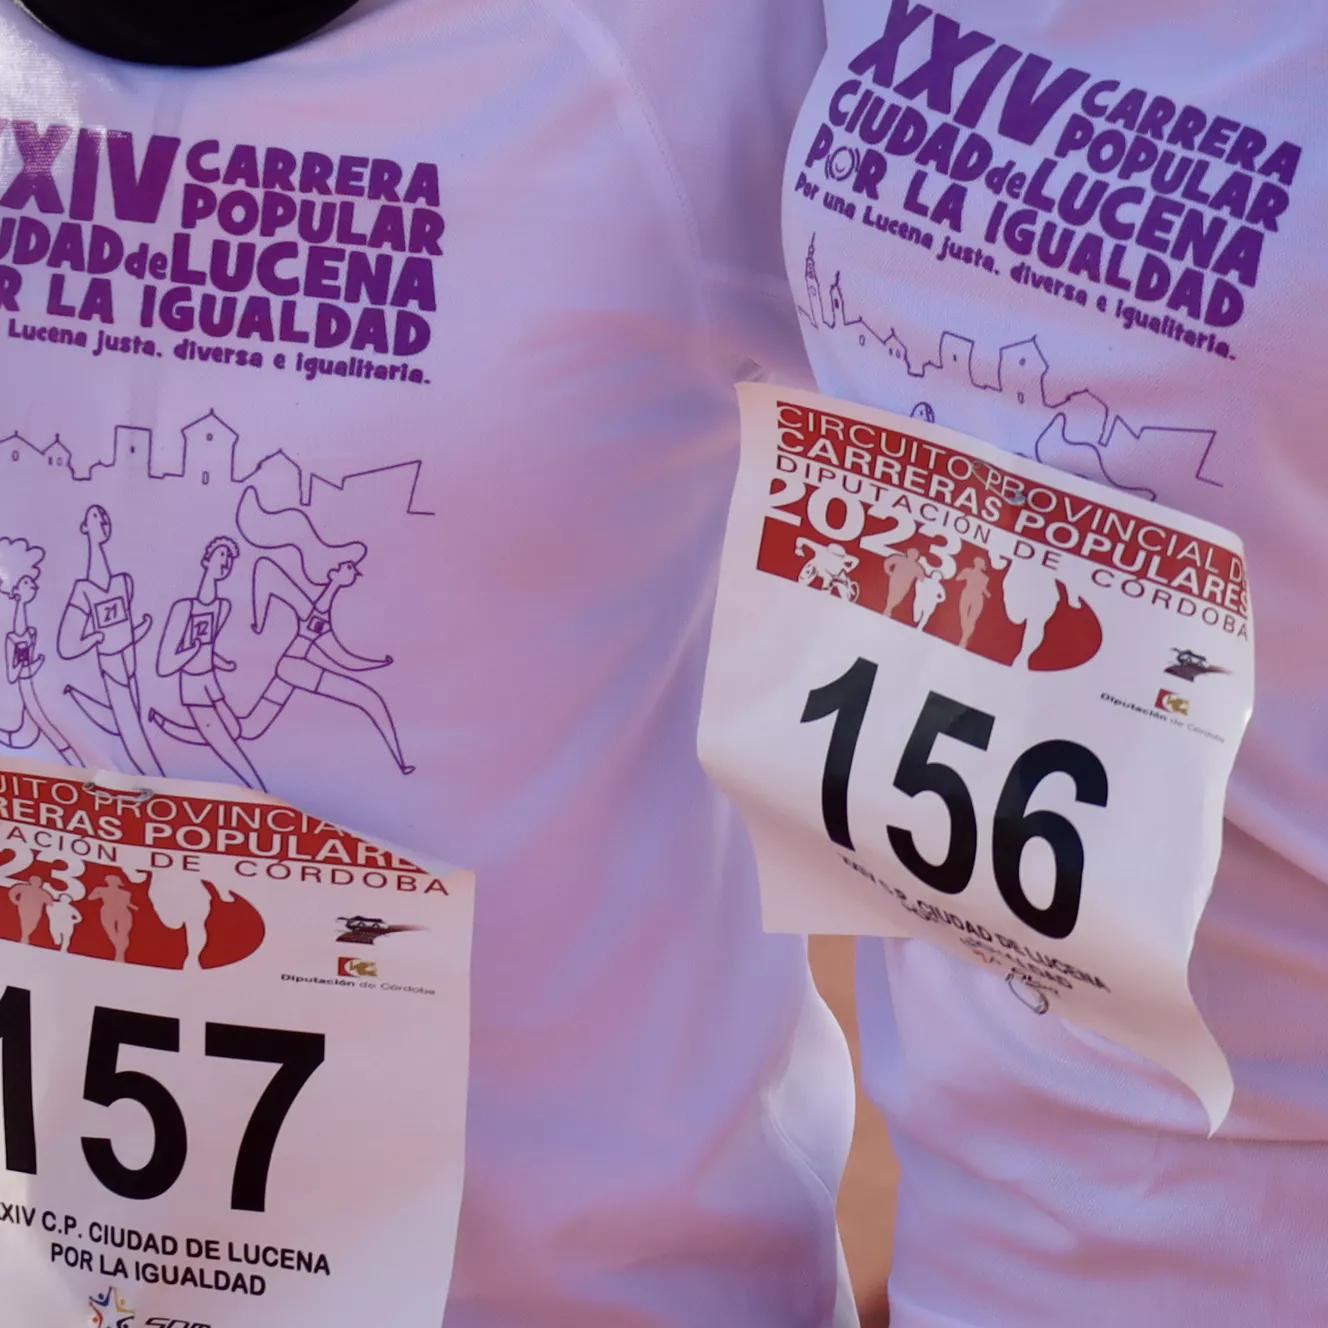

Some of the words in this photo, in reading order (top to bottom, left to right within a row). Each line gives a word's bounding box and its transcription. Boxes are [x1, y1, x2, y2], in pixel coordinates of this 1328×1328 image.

[186, 139, 441, 206] CARRERA
[1054, 113, 1289, 232] POPULAR
[1080, 79, 1302, 185] CARRERA
[181, 183, 445, 256] POPULAR
[803, 122, 888, 200] POR
[903, 169, 968, 232] LA
[985, 202, 1244, 327] IGUALDAD
[827, 79, 993, 183] CIUDAD
[985, 159, 1025, 202] de
[1025, 157, 1264, 287] LUCENA
[124, 241, 168, 280] de
[170, 232, 438, 311] LUCENA
[794, 171, 820, 201] Por
[823, 192, 856, 220] una
[862, 205, 933, 250] Lucena
[1009, 261, 1088, 311] diversa
[1095, 294, 1107, 313] e
[1116, 297, 1236, 361] igualitaria.
[8, 318, 87, 347] Lucena
[174, 339, 263, 369] diversa
[273, 352, 286, 369] e
[296, 353, 432, 385] igualitaria.
[46, 273, 114, 324] LA
[140, 285, 432, 357] IGUALDAD
[770, 475, 962, 576] 2023
[776, 405, 972, 481] CIRCUITO
[985, 467, 1219, 574] PROVINCIAL
[776, 454, 991, 546] DIPUTACIÓN
[1014, 540, 1061, 571] DE
[777, 429, 1001, 522] CARRERAS
[1014, 509, 1248, 616] POPULARES
[94, 790, 346, 837] PROVINCIA
[799, 655, 1109, 940] 156
[145, 822, 418, 869] POPULARE
[151, 852, 201, 872] DE
[235, 858, 449, 896] CÓRDOBA
[280, 974, 355, 988] Diputación
[360, 981, 376, 990] de
[41, 1210, 83, 1238] C.P.
[88, 1221, 179, 1257] CIUDAD
[186, 1238, 222, 1261] DE
[227, 1241, 331, 1276] LUCENA
[50, 1243, 94, 1272] POR
[99, 1252, 129, 1277] LA
[134, 1260, 267, 1298] IGUALDAD
